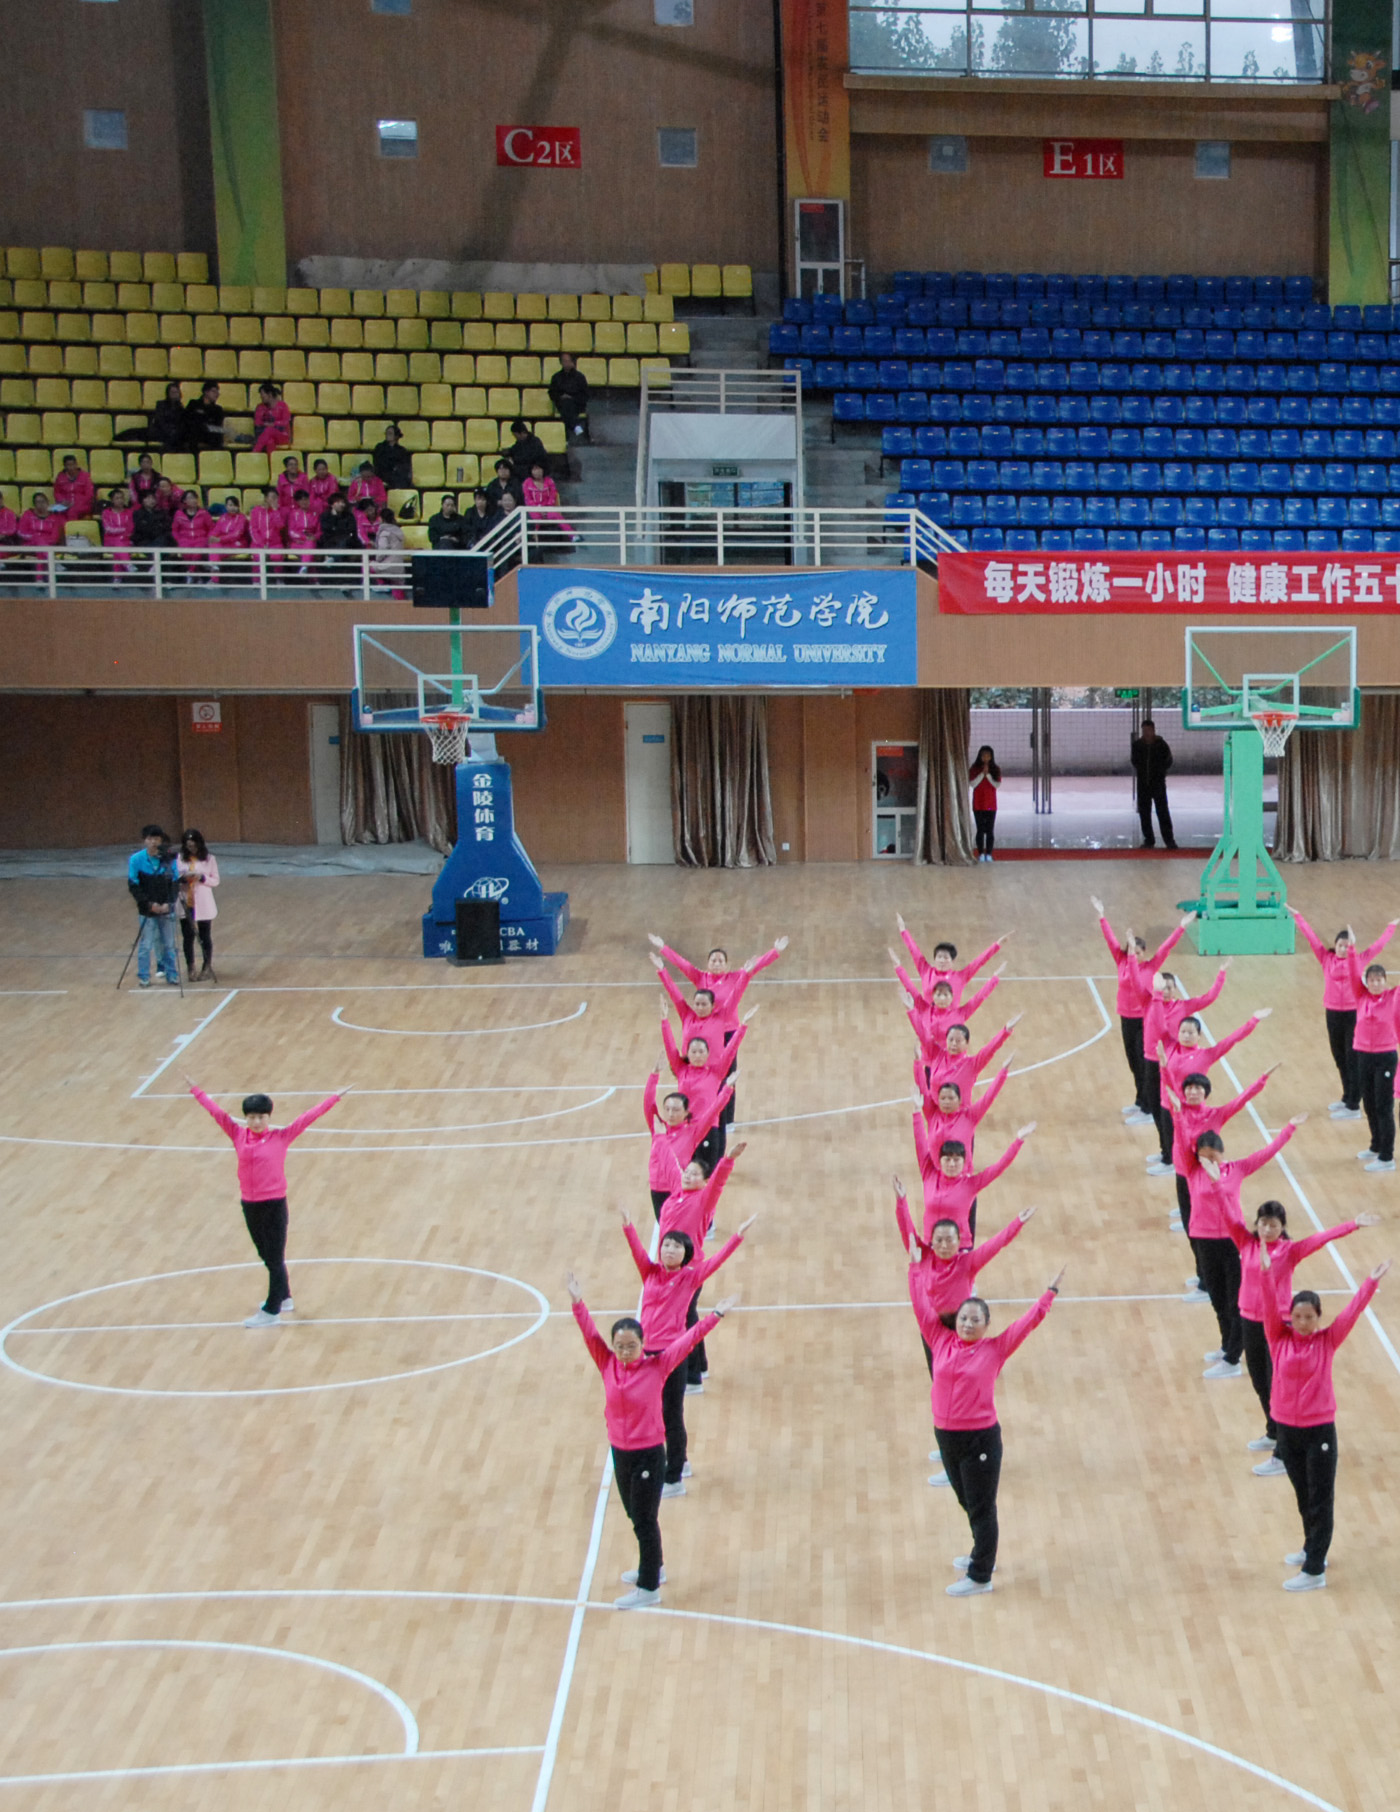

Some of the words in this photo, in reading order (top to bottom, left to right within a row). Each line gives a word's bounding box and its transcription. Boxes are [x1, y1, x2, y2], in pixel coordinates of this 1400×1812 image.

[503, 128, 575, 165] C2区
[1049, 141, 1118, 176] E1区
[984, 561, 1206, 603] 每天锻炼一小时
[629, 587, 889, 639] 南阳师范学院
[630, 643, 710, 663] NANYANG
[717, 643, 787, 663] NORMAL
[793, 643, 887, 663] UNIVERSITY
